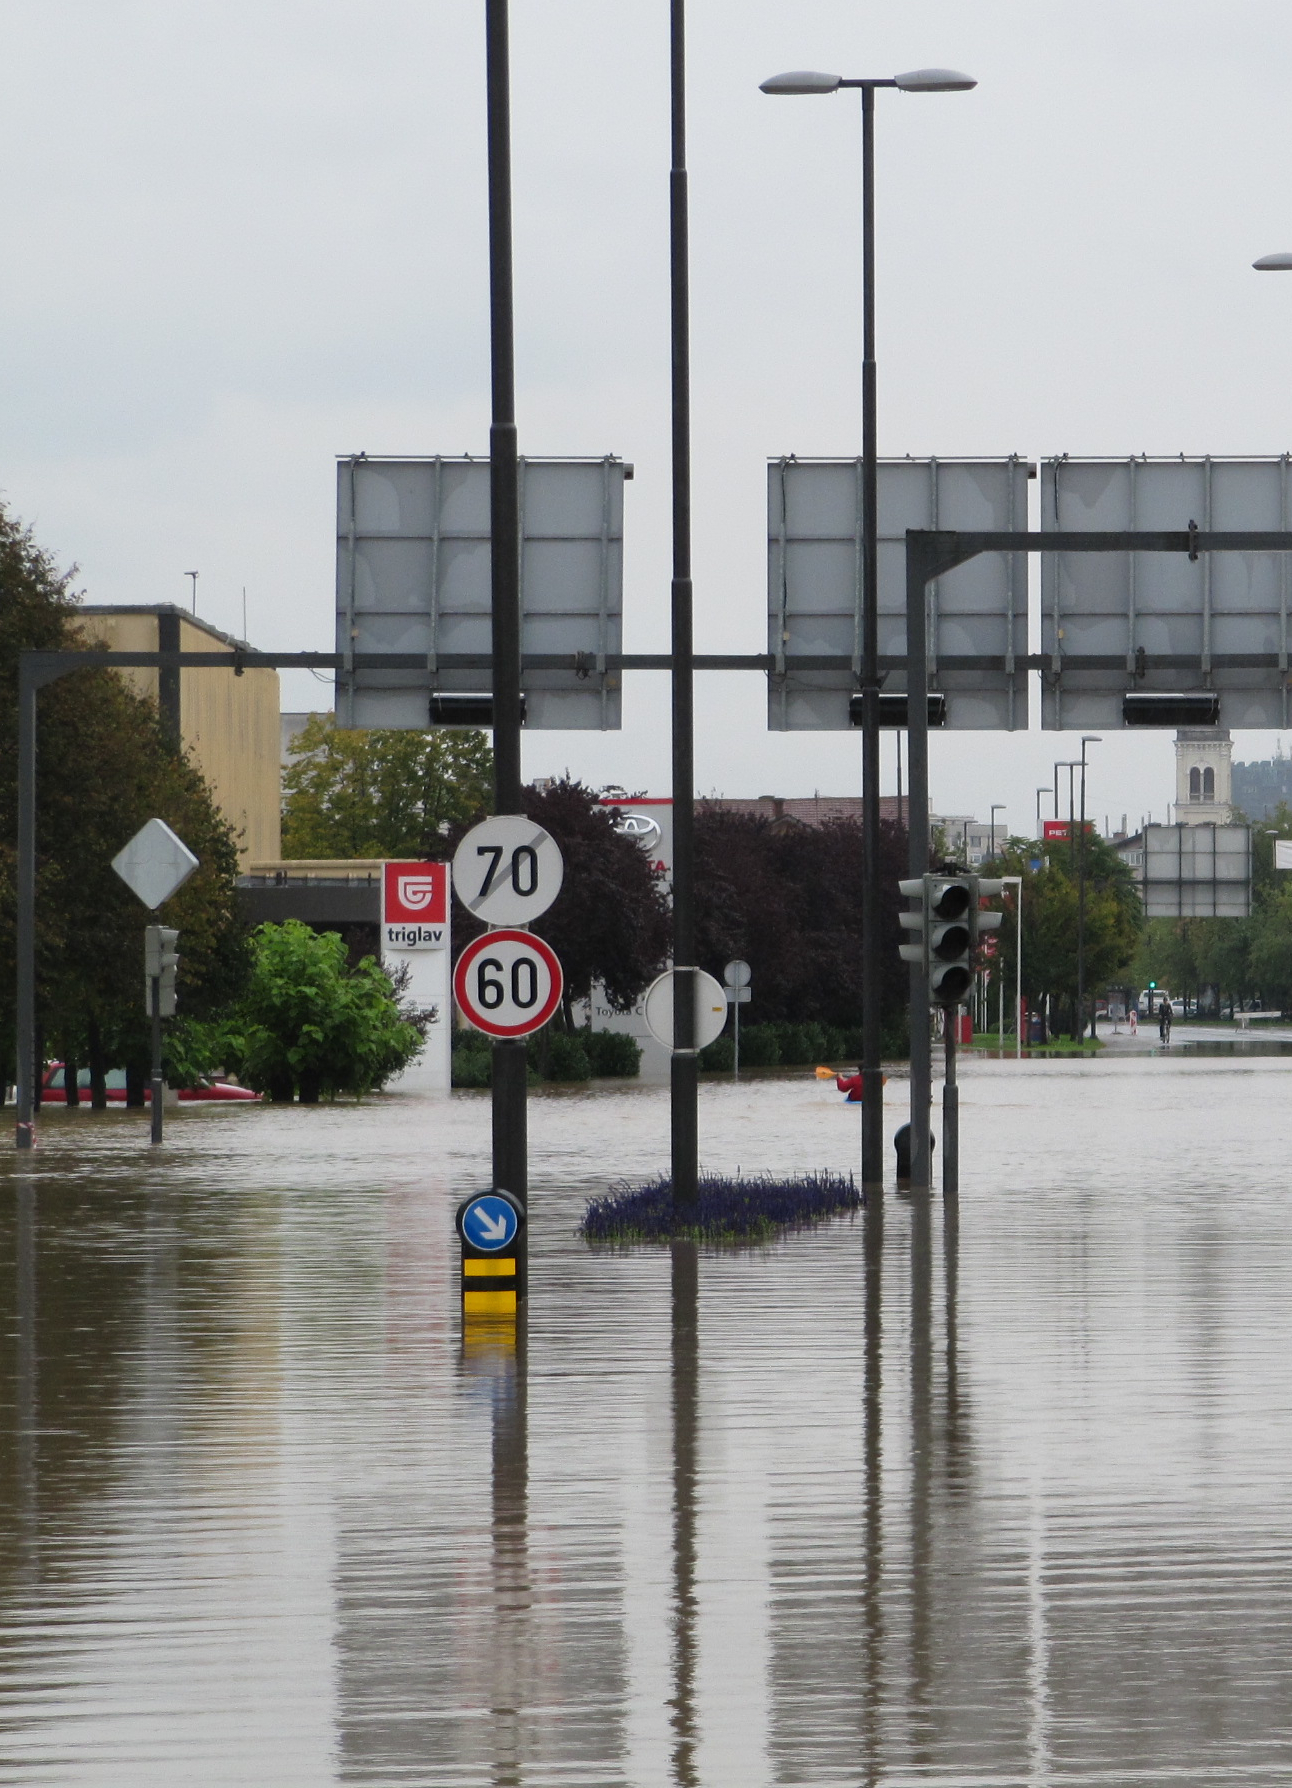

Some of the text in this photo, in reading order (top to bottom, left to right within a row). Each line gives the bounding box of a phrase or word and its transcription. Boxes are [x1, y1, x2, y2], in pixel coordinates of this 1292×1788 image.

[477, 844, 539, 897] 70
[388, 926, 442, 946] triglav
[477, 957, 539, 1009] 60
[635, 1006, 644, 1016] C
